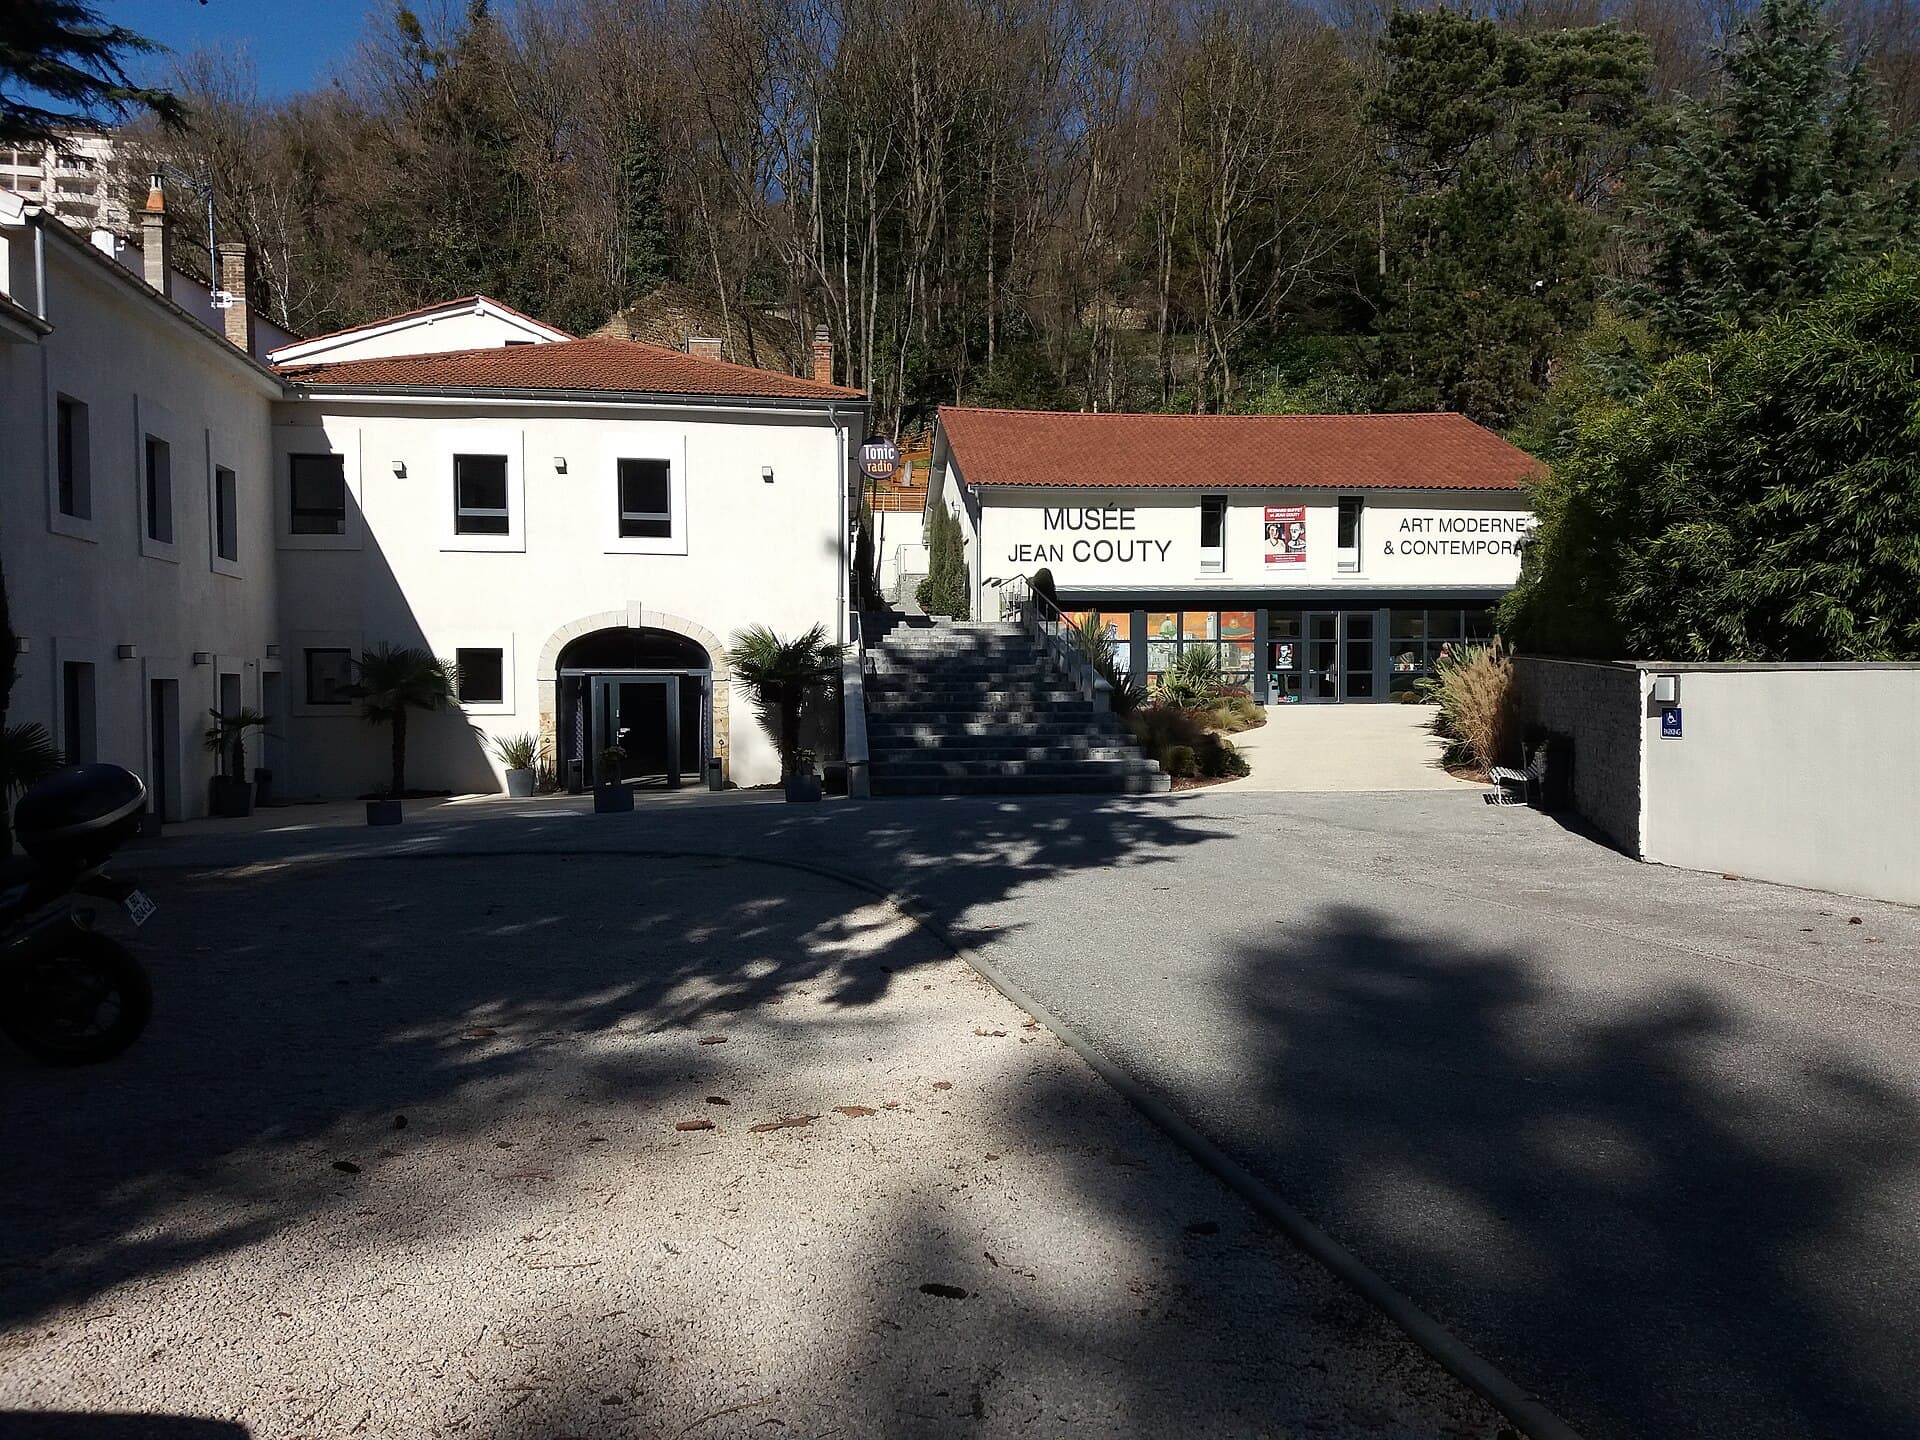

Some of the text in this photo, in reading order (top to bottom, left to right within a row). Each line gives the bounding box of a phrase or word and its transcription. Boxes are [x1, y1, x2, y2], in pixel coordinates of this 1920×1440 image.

[863, 444, 895, 460] Tonic
[866, 460, 893, 472] radio
[1044, 502, 1136, 531] MUSÉE
[1399, 517, 1526, 533] ART MODERNE
[1008, 539, 1173, 563] JEAN COUTY
[1383, 539, 1524, 556] & CONTEMPORA
